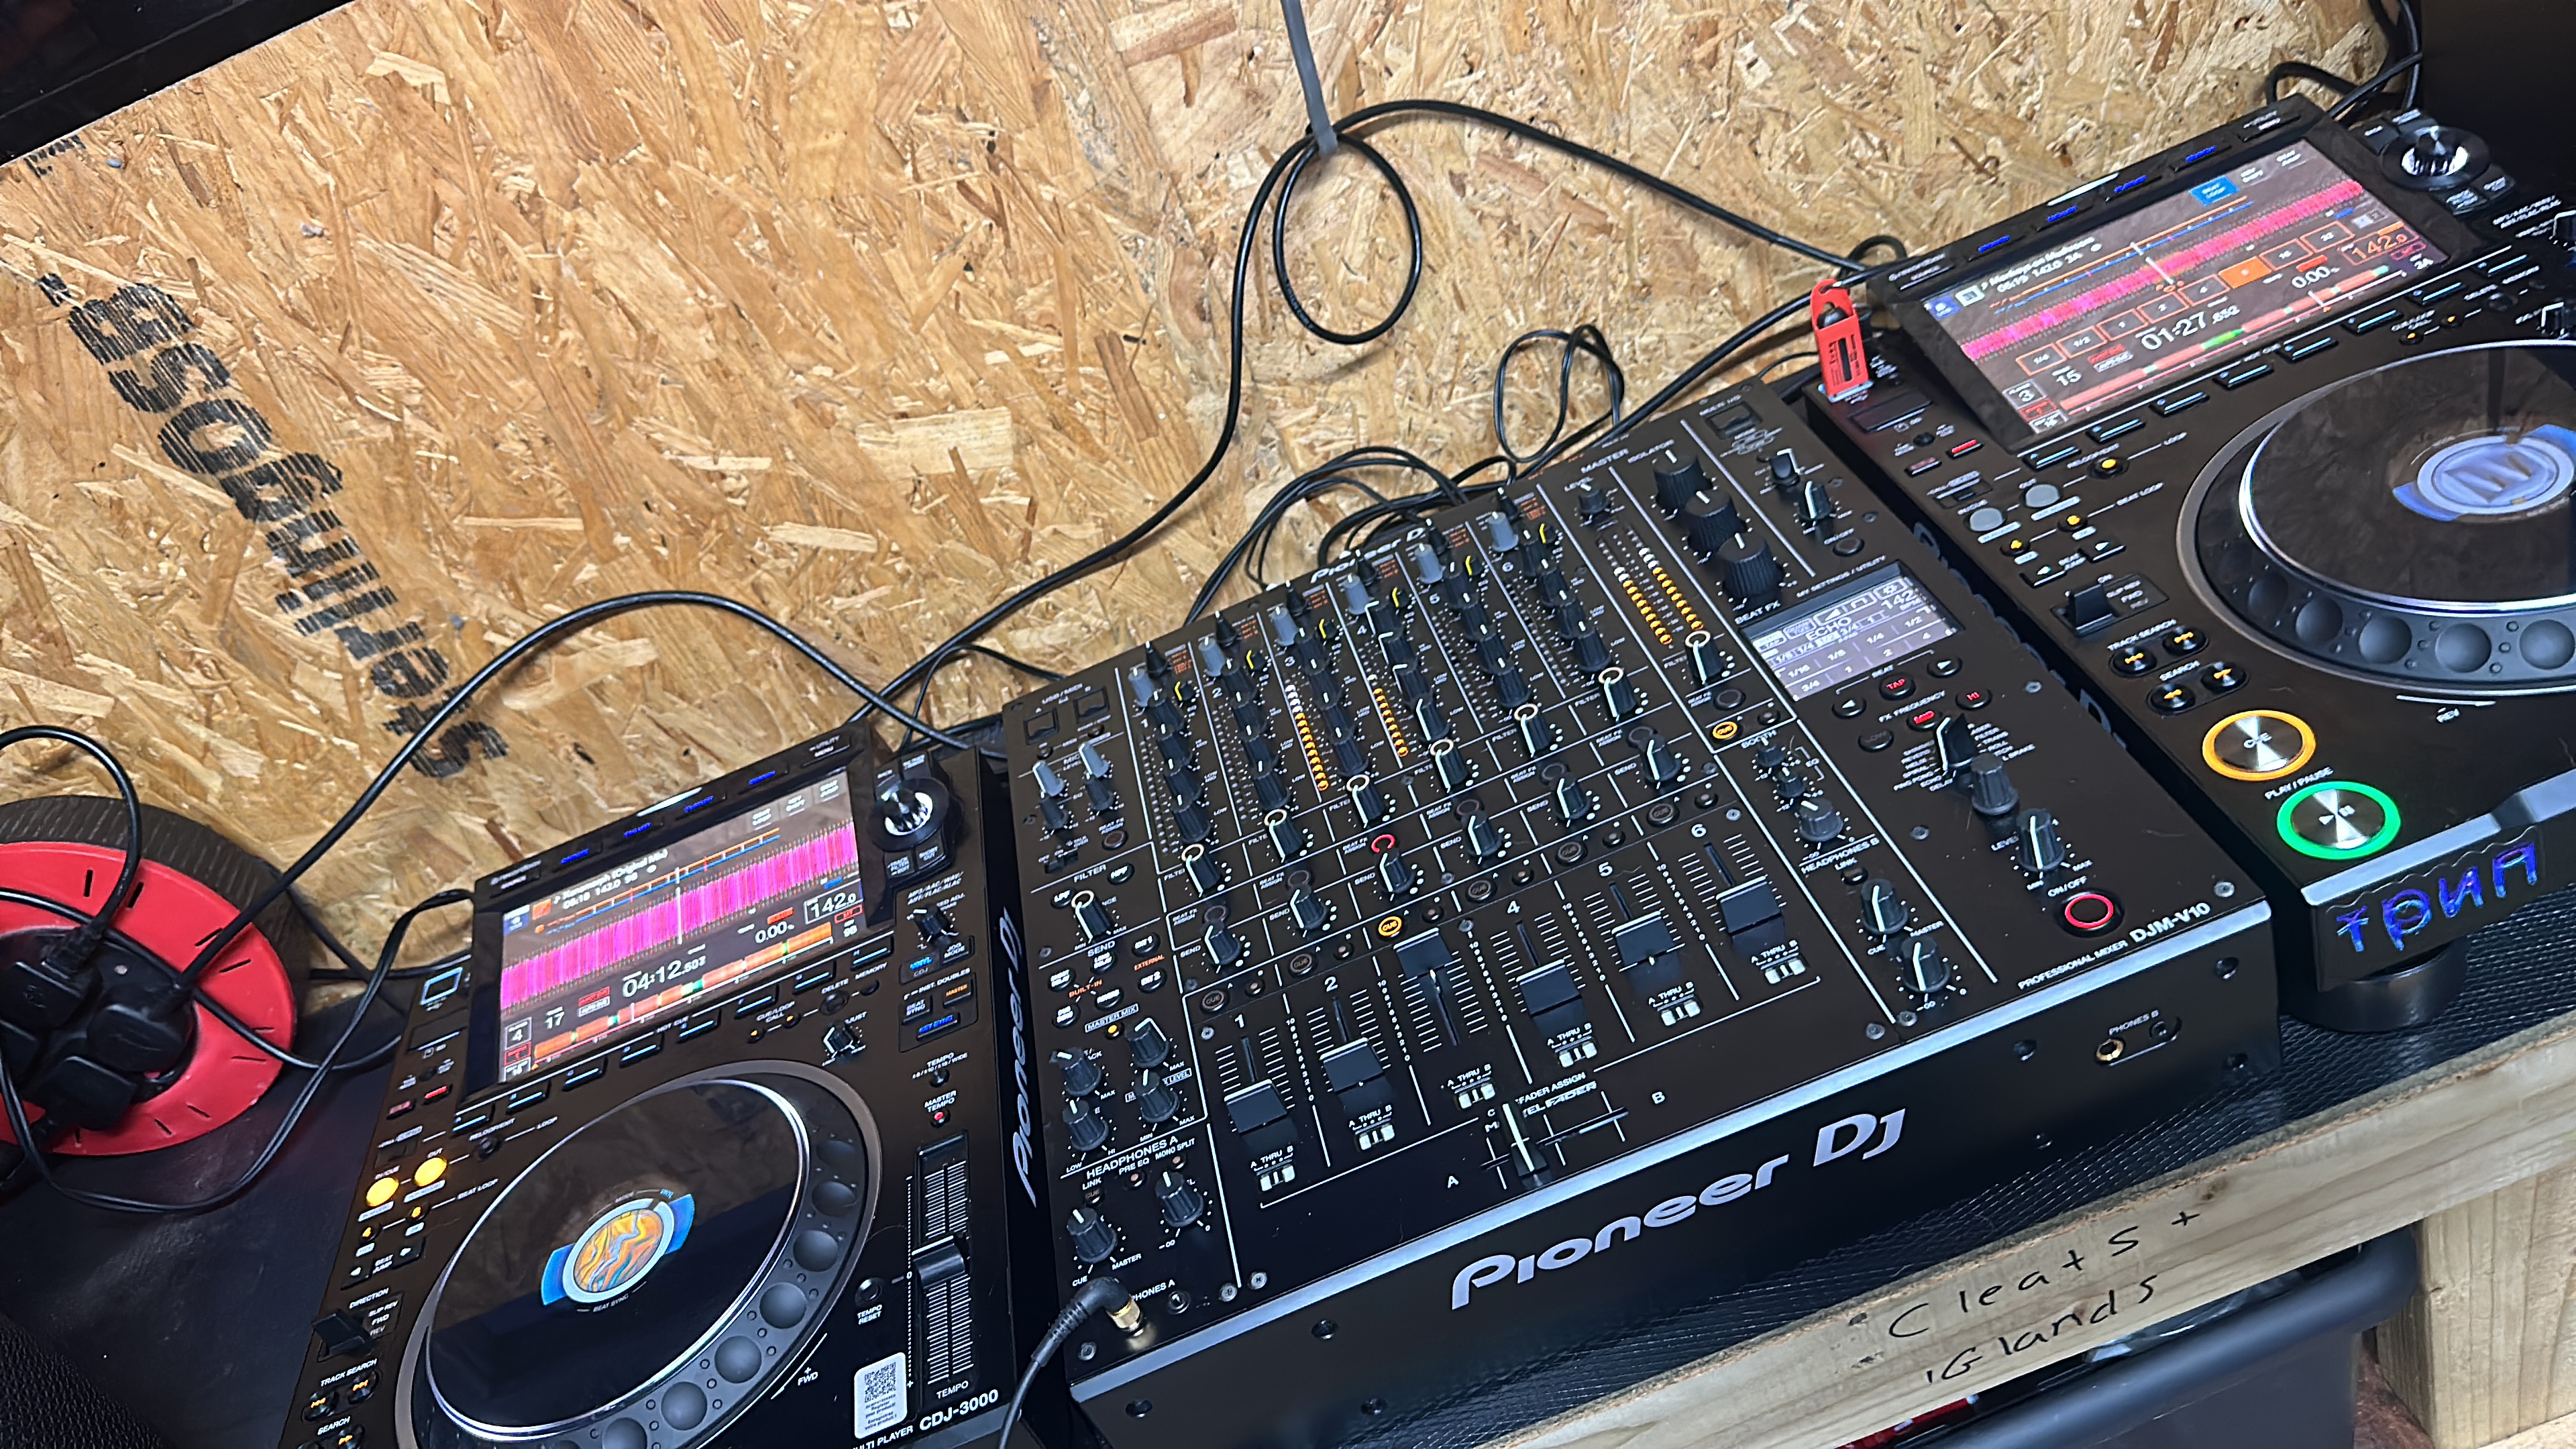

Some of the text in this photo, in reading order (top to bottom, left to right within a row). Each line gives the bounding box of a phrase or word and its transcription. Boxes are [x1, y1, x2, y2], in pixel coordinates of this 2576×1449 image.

[2351, 233, 2408, 260] 142.0
[2056, 369, 2082, 386] 15
[1881, 590, 1913, 610] 142
[1735, 601, 1781, 625] BEAT FX
[1805, 617, 1851, 641] ECHO
[1886, 678, 1906, 690] TAP
[1966, 692, 1980, 701] HI
[1691, 824, 1707, 837] 6
[1441, 837, 1462, 848] SEND
[1801, 842, 1870, 874] HEADPHONES
[1835, 857, 1858, 871] LINK
[1073, 864, 1108, 883] FILTER
[1599, 862, 1613, 876] 5
[1354, 873, 1376, 885] SEND
[2048, 876, 2087, 898] ON/OFF
[810, 892, 857, 918] 142.0
[1507, 900, 1520, 913] 4
[1269, 908, 1290, 920] SEND
[1382, 921, 1398, 931] CUE
[1087, 941, 1116, 957] SEND
[1181, 945, 1201, 957] SEND
[1751, 955, 1759, 964] A
[1760, 945, 1785, 959] THRU
[2018, 903, 2210, 989] PROFESSIONAL MIXER DJM-V10
[855, 962, 888, 980] MEMORY
[1134, 954, 1165, 971] EXTERNAL
[937, 968, 971, 987] DOUBLES
[1324, 976, 1338, 992] 2
[946, 985, 968, 997] MASTER
[1069, 979, 1103, 998] BUILT-IN
[1648, 981, 1694, 1005] A THRU B
[545, 1010, 565, 1030] 17
[757, 1001, 795, 1022] CUE/LOOP
[765, 1012, 785, 1023] CALL
[1087, 1006, 1136, 1031] MASTER MIX
[1234, 1014, 1244, 1028] 1
[2109, 1014, 2148, 1036] PHONES
[513, 1030, 523, 1041] 4
[1548, 1022, 1592, 1046] A THRU B
[926, 1053, 955, 1067] TEMPO
[1169, 1061, 1185, 1071] MAX
[1176, 1070, 1191, 1081] LEVEL
[1457, 1067, 1480, 1081] THRU
[1484, 1063, 1491, 1071] B
[1008, 968, 1036, 1208] Pioneer
[1551, 1072, 1586, 1091] ASSIGN
[924, 1090, 957, 1108] MASTER
[1100, 1089, 1116, 1099] MAX
[1652, 1091, 1665, 1104] B
[927, 1097, 955, 1112] TEMPO
[1179, 1115, 1195, 1126] MAX
[1348, 1104, 1392, 1128] A THRU B
[1140, 1132, 1153, 1142] MIN
[427, 1148, 443, 1159] OUT
[1087, 1136, 1179, 1179] HEADPHONES A
[1155, 1138, 1195, 1161] MONO SPLIT
[1066, 1163, 1082, 1173] LOW
[1118, 1158, 1150, 1175] PRE EQ
[1250, 1160, 1257, 1169] A
[1260, 1150, 1283, 1163] THRU
[1082, 1177, 1102, 1191] LINK
[1448, 1176, 1458, 1188] A
[1451, 1153, 1790, 1310] Pioneer
[1112, 1253, 1142, 1270] MASTER
[1072, 1276, 1087, 1287] CUE
[1131, 1279, 1175, 1301] PHONES A
[349, 1288, 389, 1309] DIRECTION
[372, 1313, 390, 1326] FWD
[857, 1305, 882, 1319] TEMPO
[859, 1311, 881, 1325] RESET
[370, 1326, 386, 1336] REV
[321, 1358, 377, 1387] TRACK SEARCH
[798, 1371, 818, 1386] FWD
[936, 1381, 969, 1399] TEMPO
[317, 1416, 350, 1436] SEARCH
[877, 1426, 914, 1446] PLAYER
[920, 1389, 998, 1430] CDJ-3000
